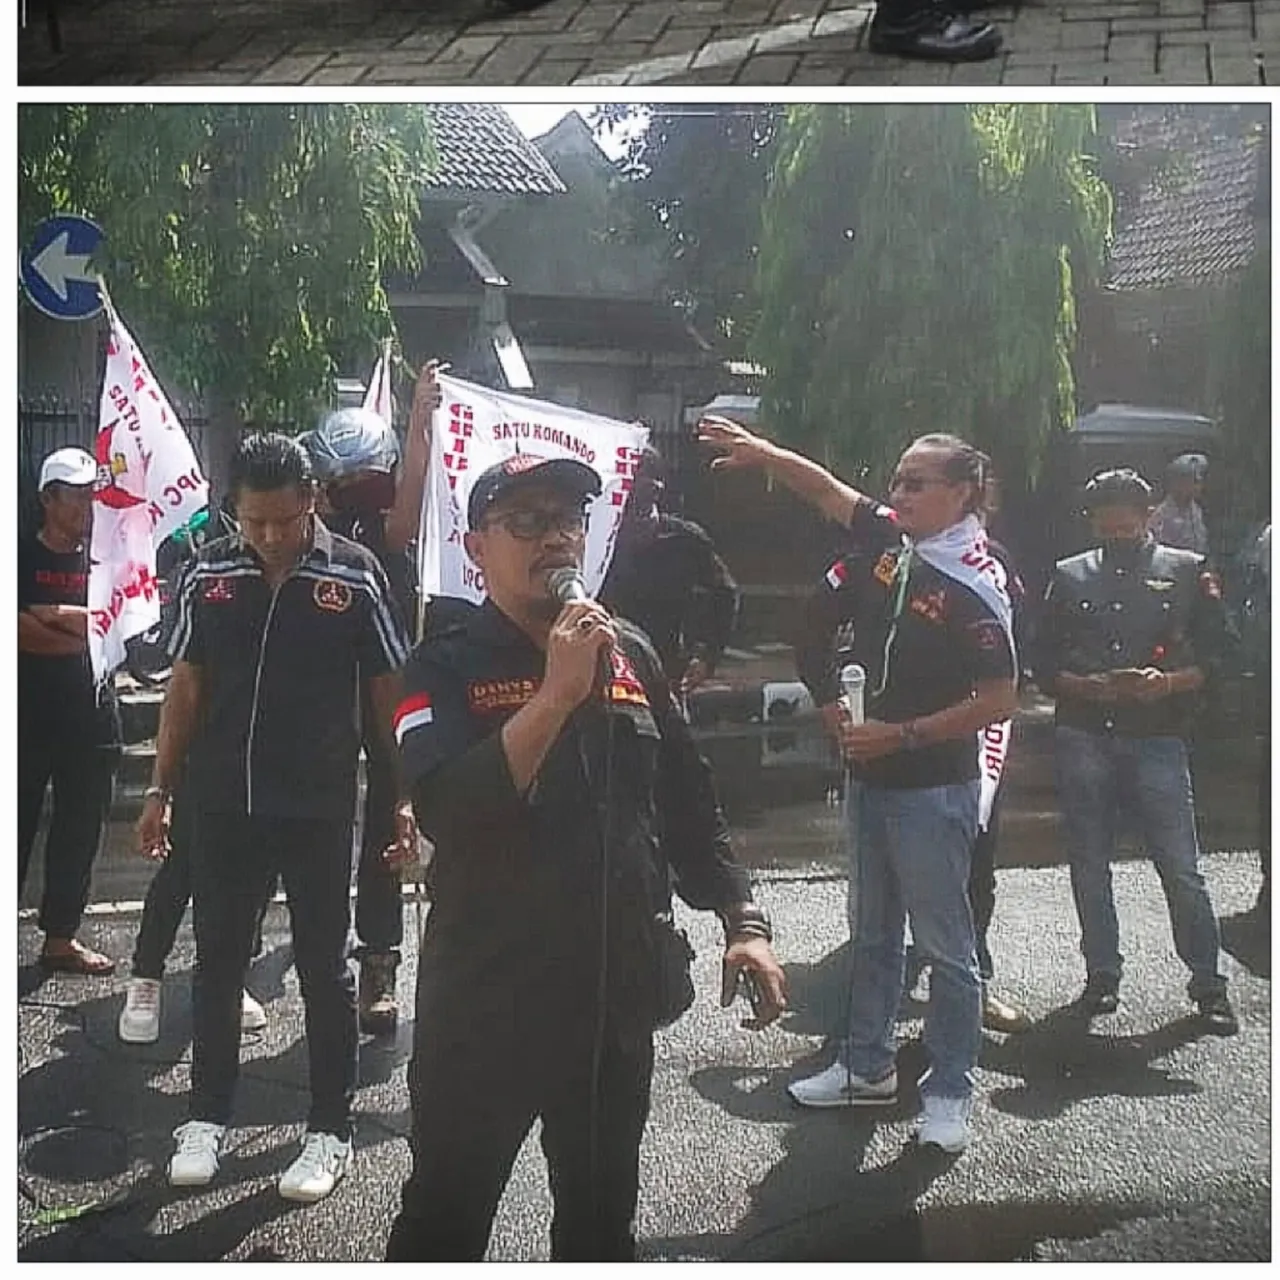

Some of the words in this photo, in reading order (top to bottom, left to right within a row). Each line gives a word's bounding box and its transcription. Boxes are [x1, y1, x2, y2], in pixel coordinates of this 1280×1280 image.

[108, 384, 141, 432] SATU
[493, 422, 530, 440] SATU
[533, 423, 595, 464] KOMANDO
